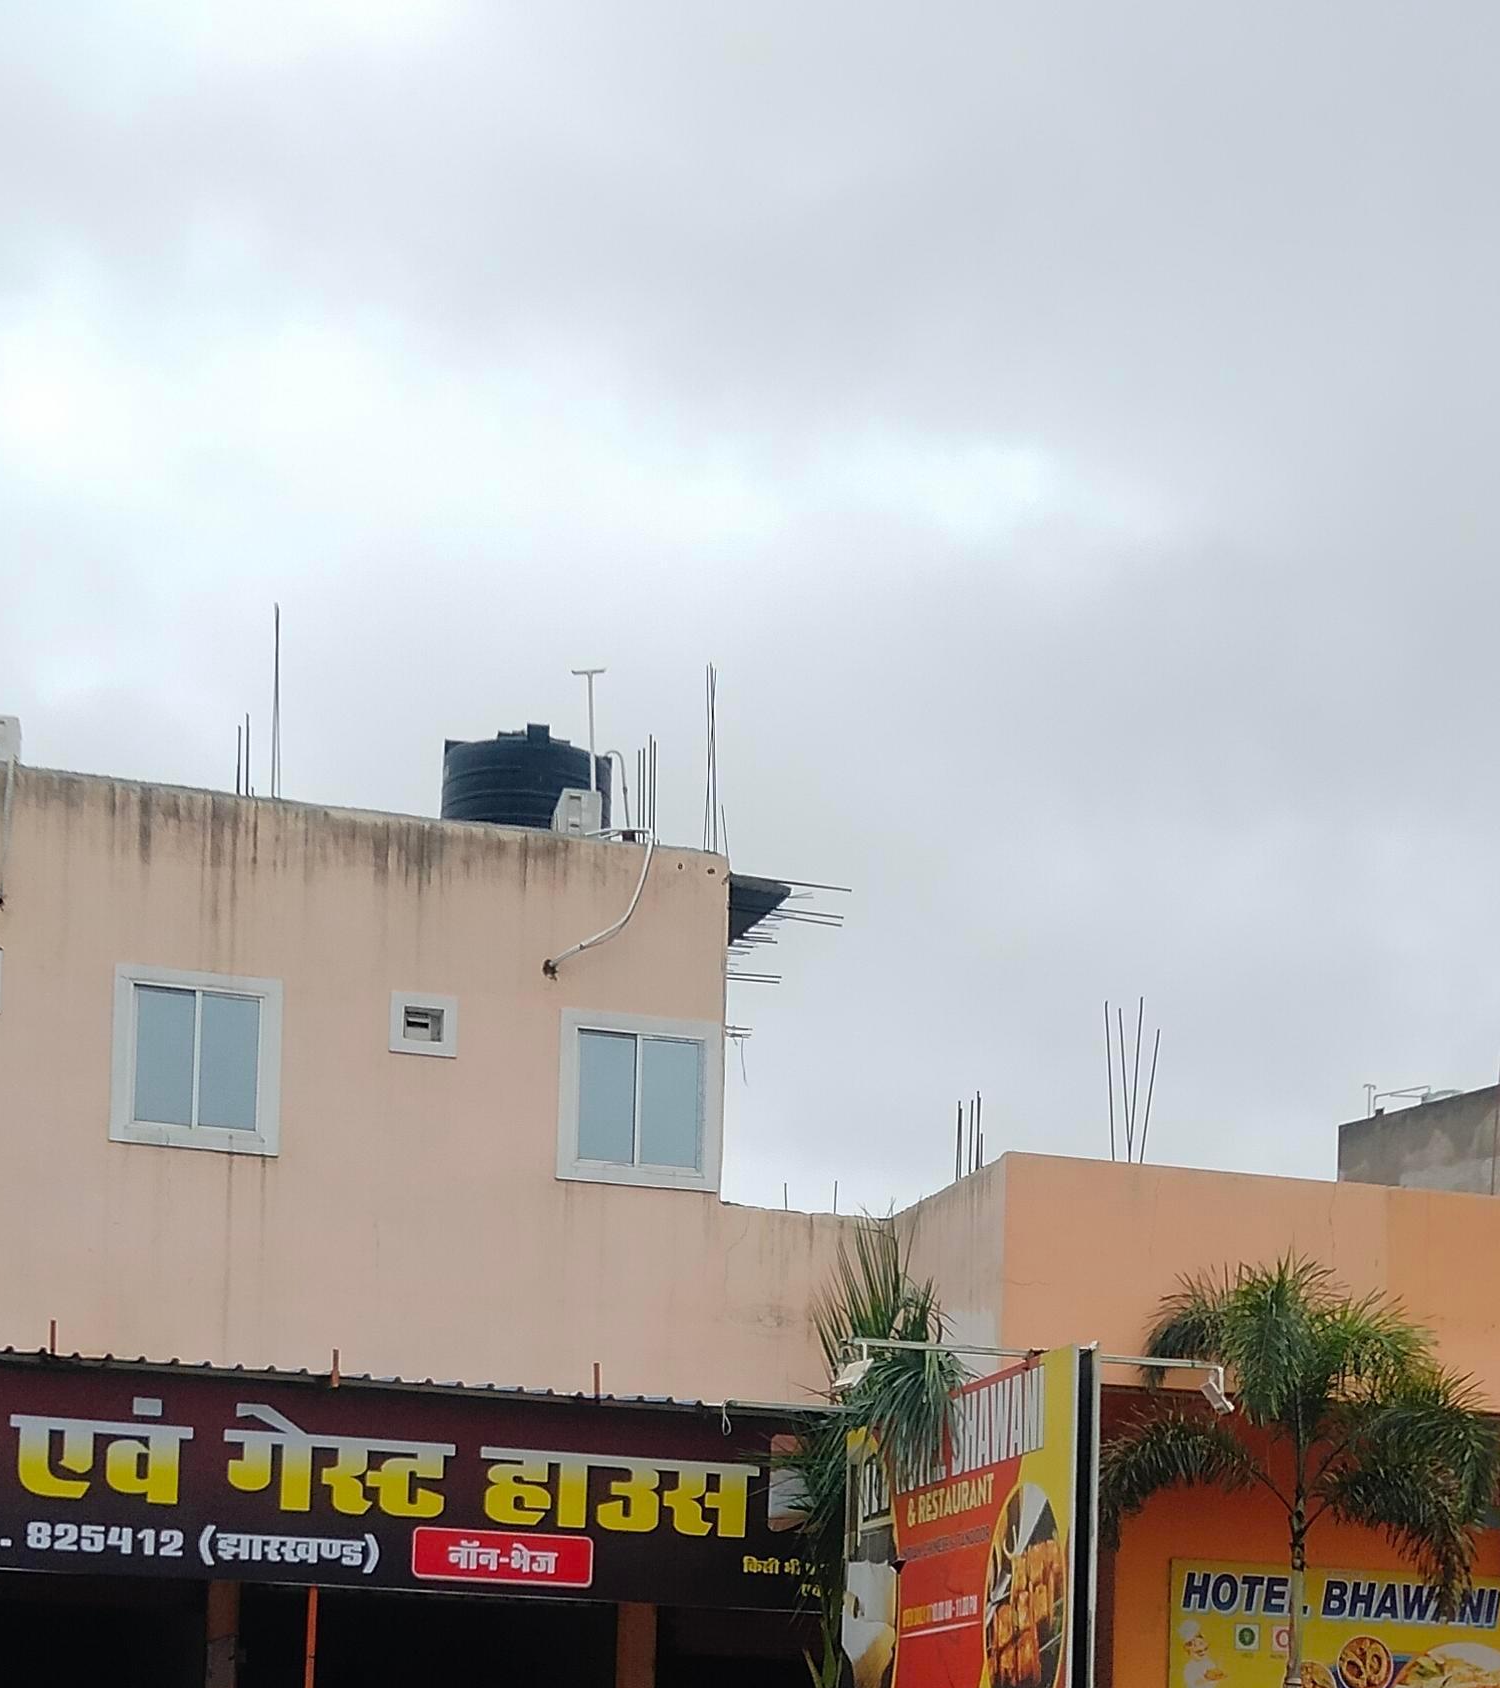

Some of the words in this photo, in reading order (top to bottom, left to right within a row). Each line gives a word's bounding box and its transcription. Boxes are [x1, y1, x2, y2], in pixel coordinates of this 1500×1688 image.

[10, 1396, 194, 1504] एवं
[223, 1403, 456, 1518] गेस्ट
[480, 1446, 760, 1538] हाउस
[906, 1499, 916, 1528] &
[918, 1473, 995, 1523] RESTAURANT
[26, 1522, 184, 1557] 825412
[200, 1525, 380, 1574] (झारखण्ड)
[1182, 1572, 1308, 1618] HOTE
